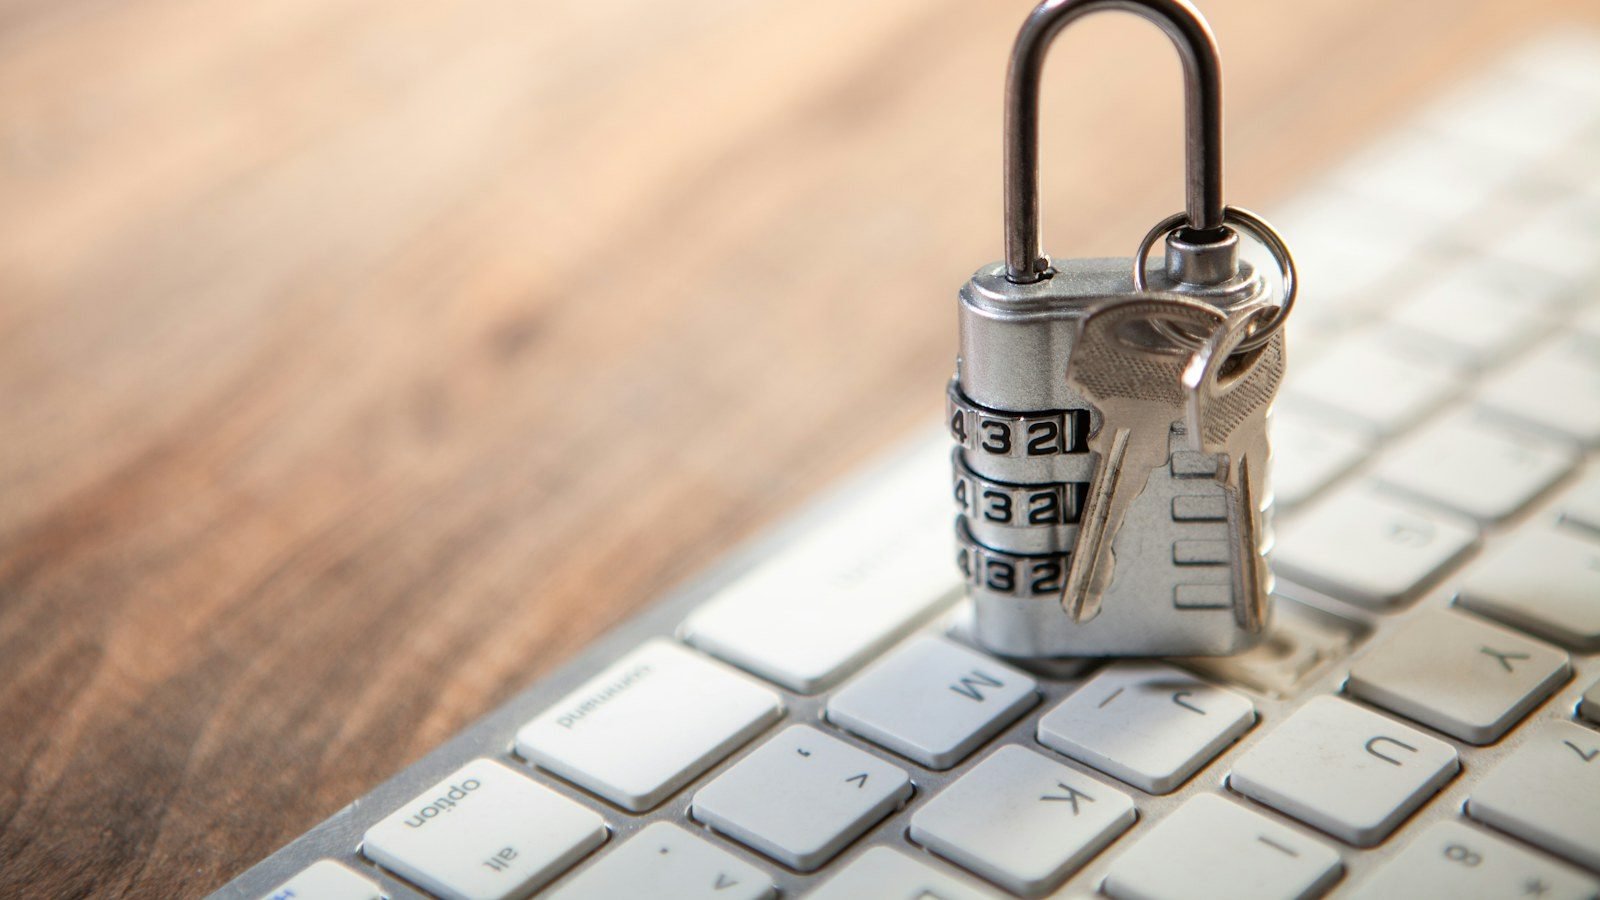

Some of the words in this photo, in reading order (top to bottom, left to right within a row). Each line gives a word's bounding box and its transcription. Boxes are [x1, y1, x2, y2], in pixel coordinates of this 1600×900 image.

[1480, 645, 1530, 673] Y
[949, 669, 1004, 703] M
[1172, 690, 1206, 716] J
[1364, 736, 1418, 766] U
[1562, 739, 1600, 762] 7
[403, 778, 481, 829] option
[1039, 783, 1095, 816] K
[482, 846, 518, 873] alt
[1444, 843, 1482, 867] 8
